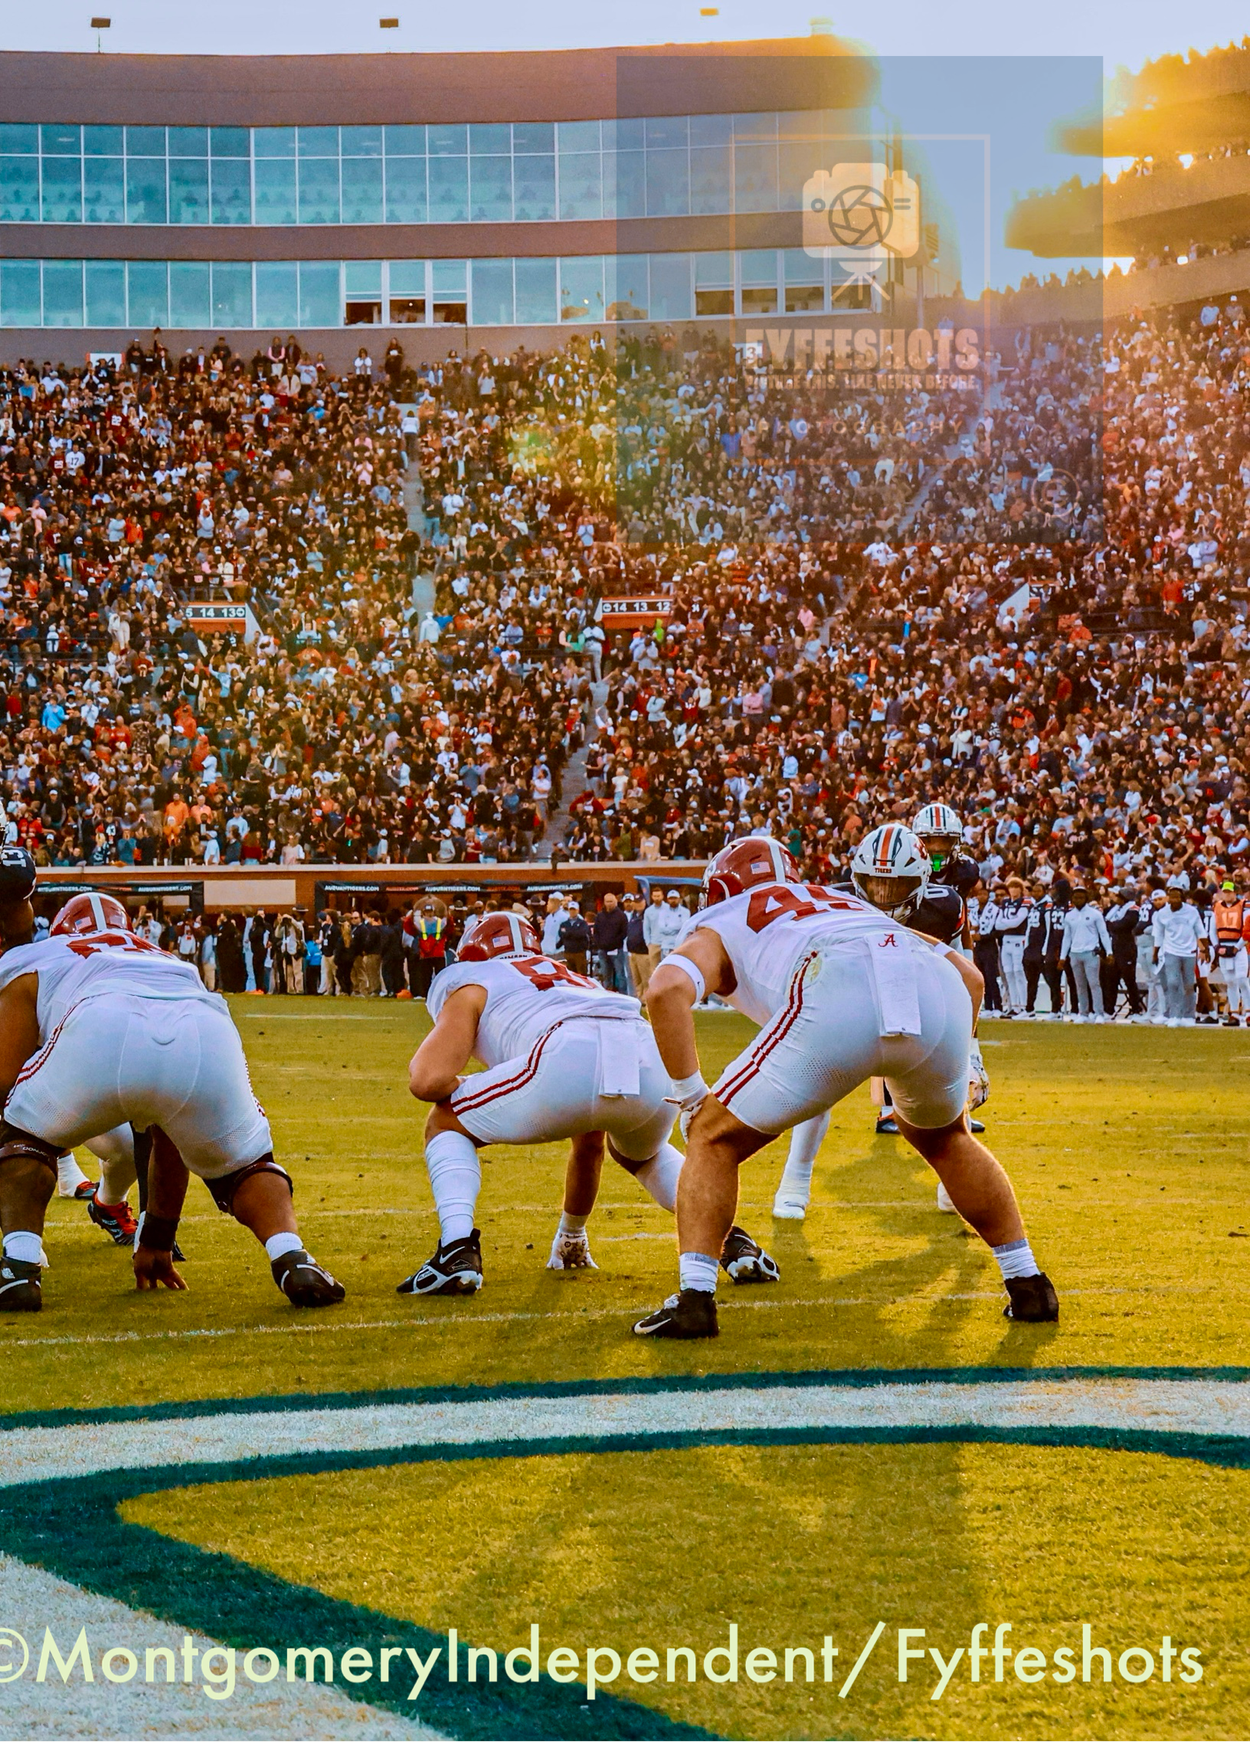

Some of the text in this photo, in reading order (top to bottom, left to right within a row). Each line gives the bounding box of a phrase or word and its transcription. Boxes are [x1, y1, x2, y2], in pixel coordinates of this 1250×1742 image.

[199, 607, 215, 618] 14
[612, 601, 671, 613] 14 13 12
